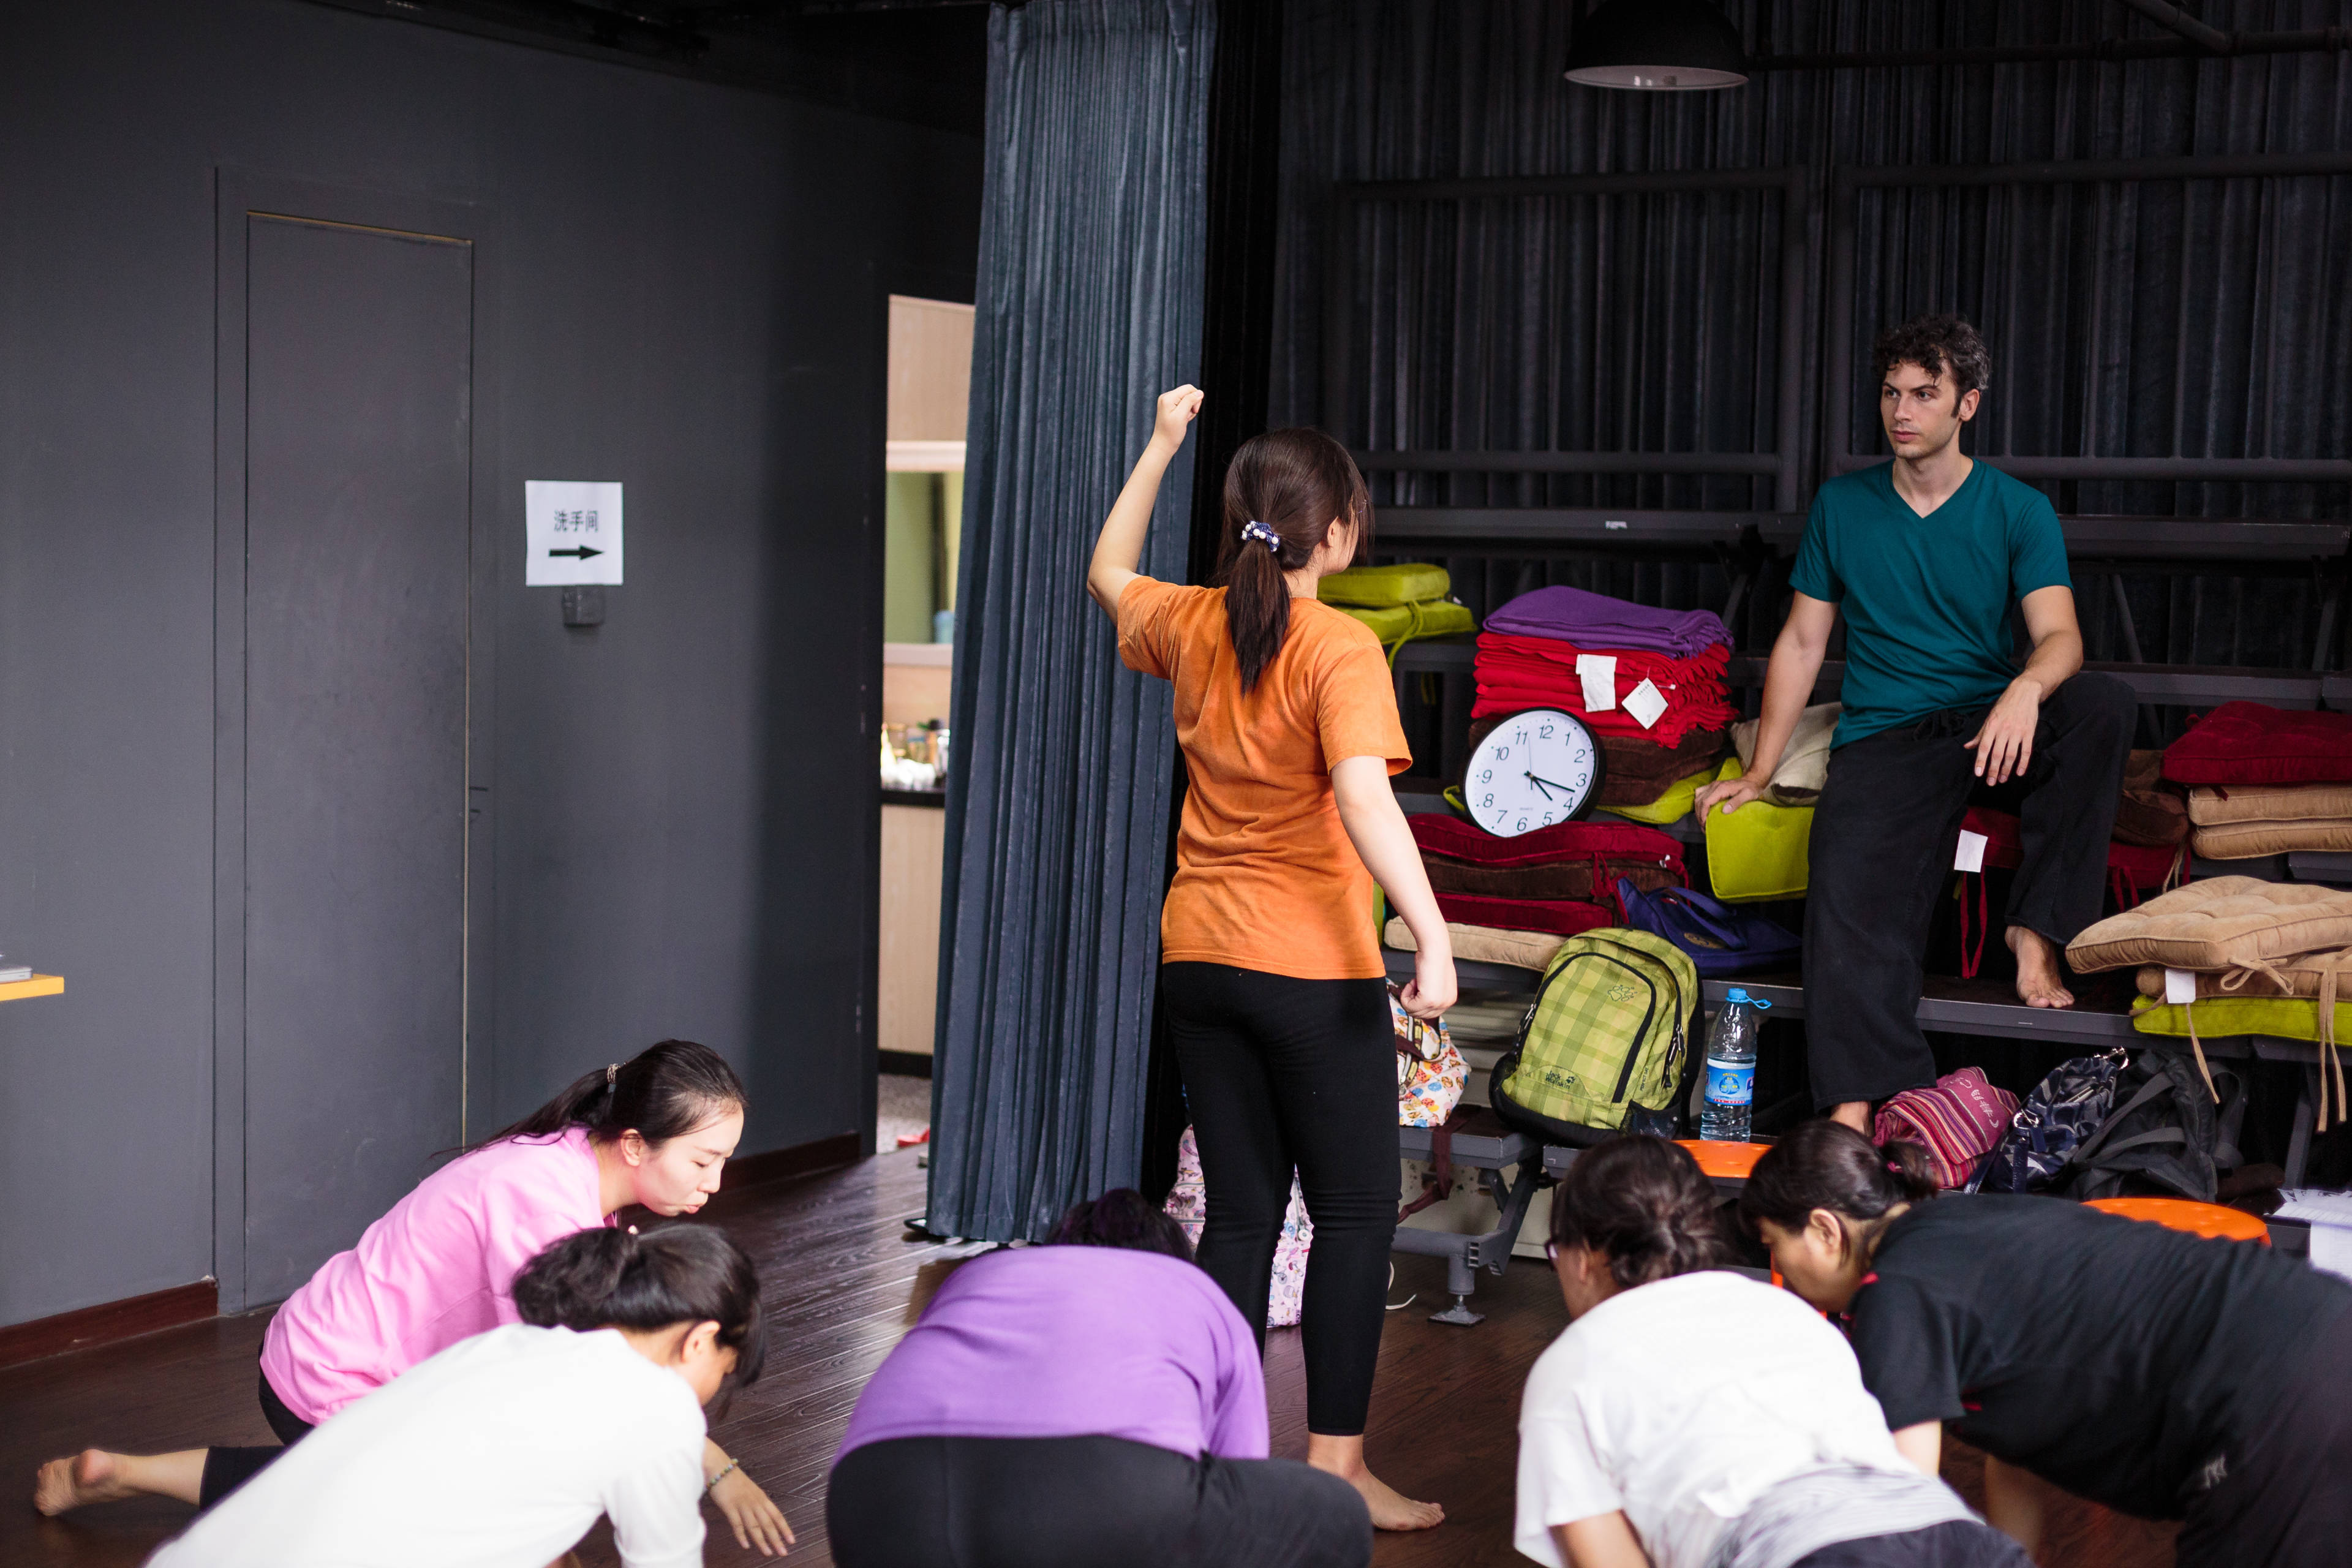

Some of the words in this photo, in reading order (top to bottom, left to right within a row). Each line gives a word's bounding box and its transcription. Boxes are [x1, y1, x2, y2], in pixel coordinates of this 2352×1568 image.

[553, 510, 599, 532] 洗手间
[1515, 731, 1528, 745] 11
[1539, 725, 1554, 739] 12
[1564, 732, 1571, 746] 1
[1495, 747, 1509, 761] 10
[1574, 749, 1586, 763] 2
[1481, 769, 1493, 784] 9
[1575, 773, 1587, 787] 3
[1482, 793, 1494, 808] 8
[1562, 796, 1574, 811] 4
[1497, 810, 1508, 824] 7
[1542, 812, 1553, 826] 5
[1517, 817, 1528, 832] 6
